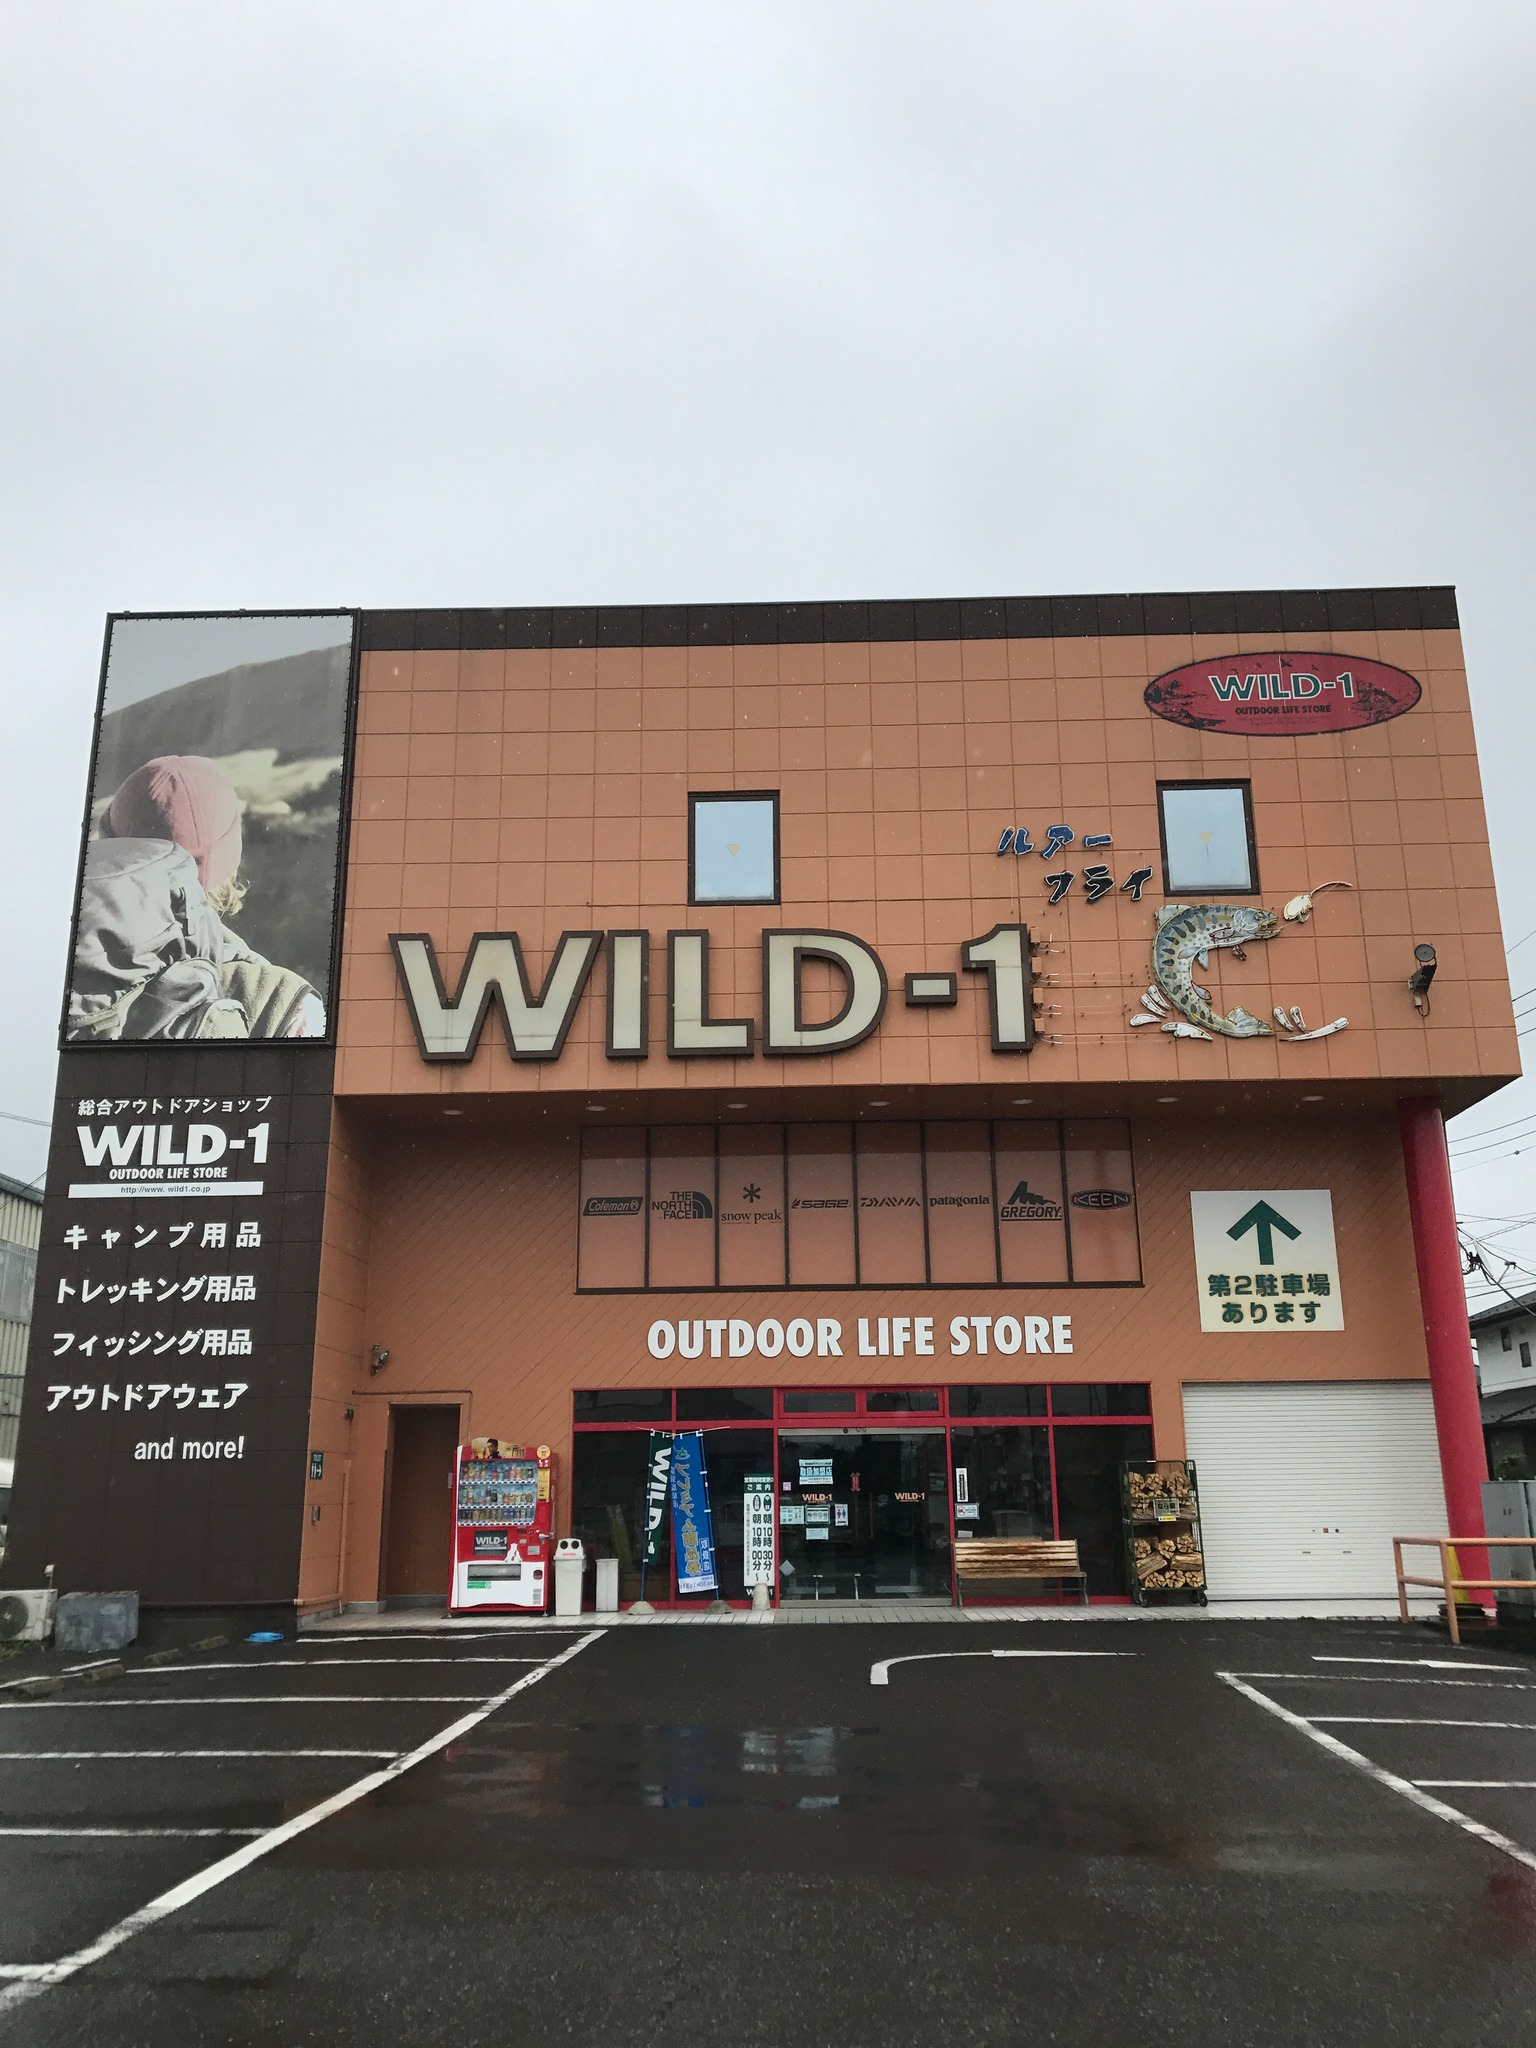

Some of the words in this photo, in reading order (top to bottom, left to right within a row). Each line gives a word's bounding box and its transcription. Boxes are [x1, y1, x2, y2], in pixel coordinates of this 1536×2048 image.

[1208, 672, 1354, 701] WILD-1
[1235, 705, 1279, 715] OUTDOOR
[1282, 705, 1300, 714] LIFE
[1302, 704, 1331, 713] STORE
[997, 824, 1113, 860] ルアー
[1044, 864, 1153, 904] フライ
[387, 923, 1033, 1060] WILD-1
[77, 1095, 272, 1116] 総合アウトドアショップ
[76, 1123, 270, 1167] WILD-1
[109, 1168, 163, 1180] OUTDOOR
[167, 1168, 190, 1179] LIFE
[193, 1167, 228, 1179] STORE
[588, 1200, 629, 1212] Coleman
[652, 1201, 692, 1210] NORTH
[670, 1191, 691, 1201] THE
[929, 1195, 990, 1207] patagonia
[1073, 1193, 1129, 1206] KEEN
[663, 1210, 692, 1219] FACE
[721, 1213, 751, 1221] snow
[754, 1209, 782, 1224] peak
[56, 1275, 256, 1304] トレッキング用品
[1207, 1273, 1331, 1297] 第2駐車場
[1221, 1301, 1321, 1324] あります
[52, 1328, 253, 1358] フィッシング用品
[647, 1317, 844, 1359] OUTDOOR
[857, 1316, 935, 1357] LIFE
[949, 1315, 1074, 1356] STORE
[46, 1383, 248, 1411] アウトドアウェア
[134, 1437, 174, 1461] and
[182, 1435, 245, 1459] more!
[802, 1493, 832, 1501] WILD-1
[894, 1492, 925, 1500] WILD-1
[475, 1536, 507, 1545] WILD-1
